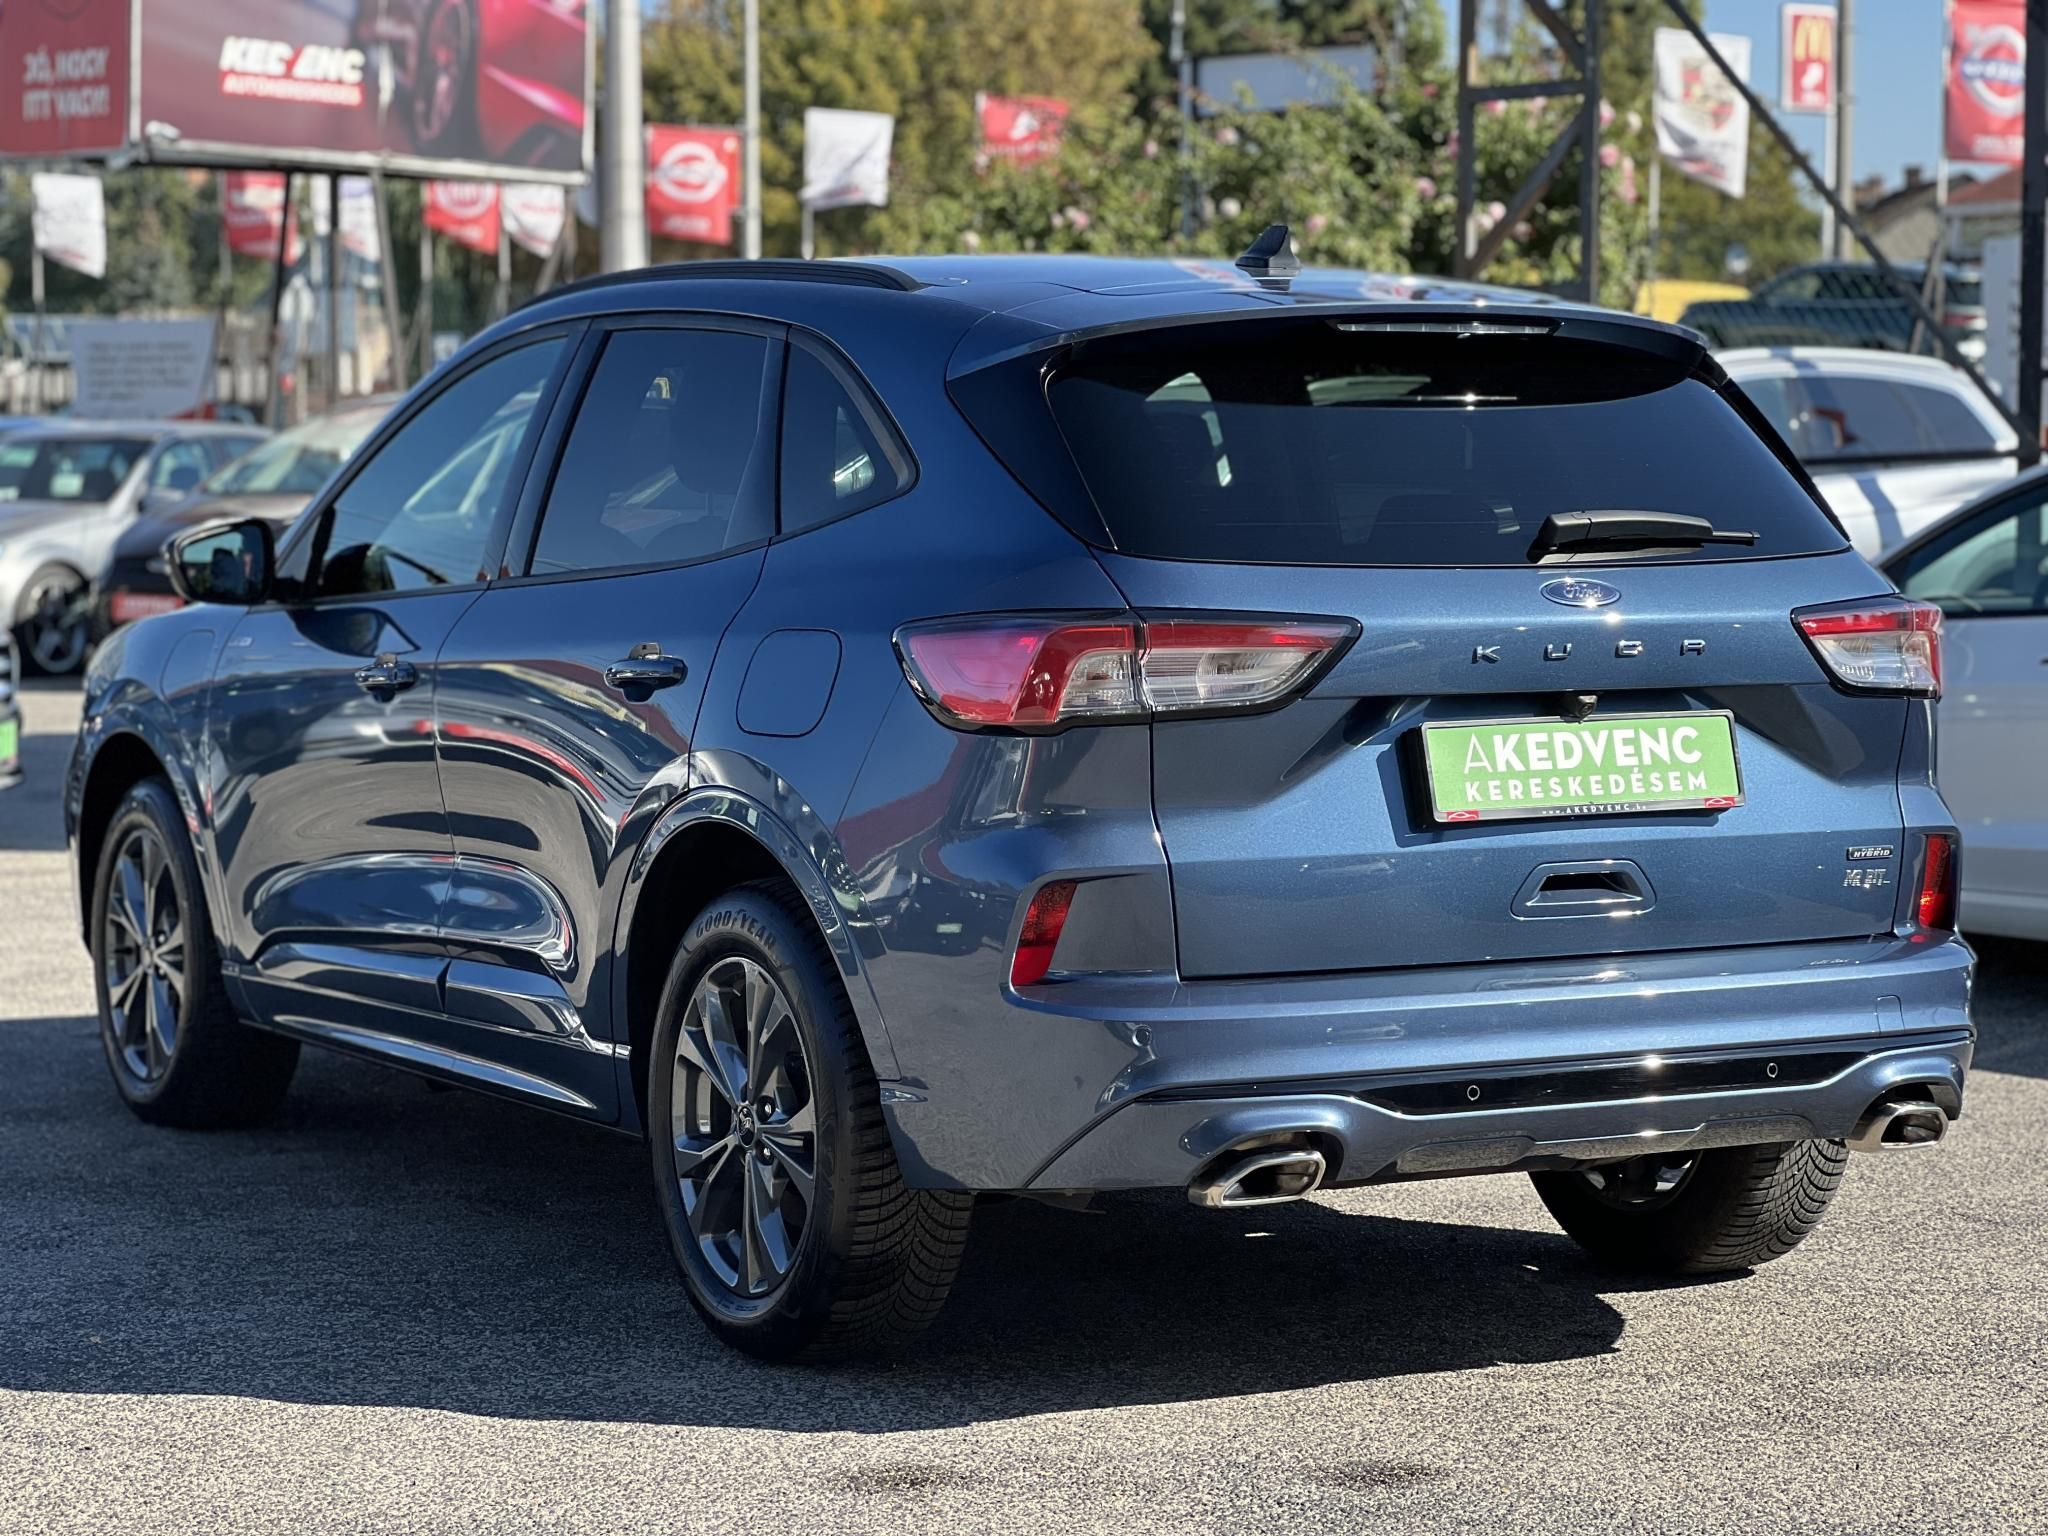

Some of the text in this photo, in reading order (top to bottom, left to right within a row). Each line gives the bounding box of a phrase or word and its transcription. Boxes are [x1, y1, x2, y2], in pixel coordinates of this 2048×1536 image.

[1473, 639, 1706, 664] KUGA
[1465, 767, 1707, 803] KERESKEDÉSEM
[1853, 849, 1890, 858] HYBRID
